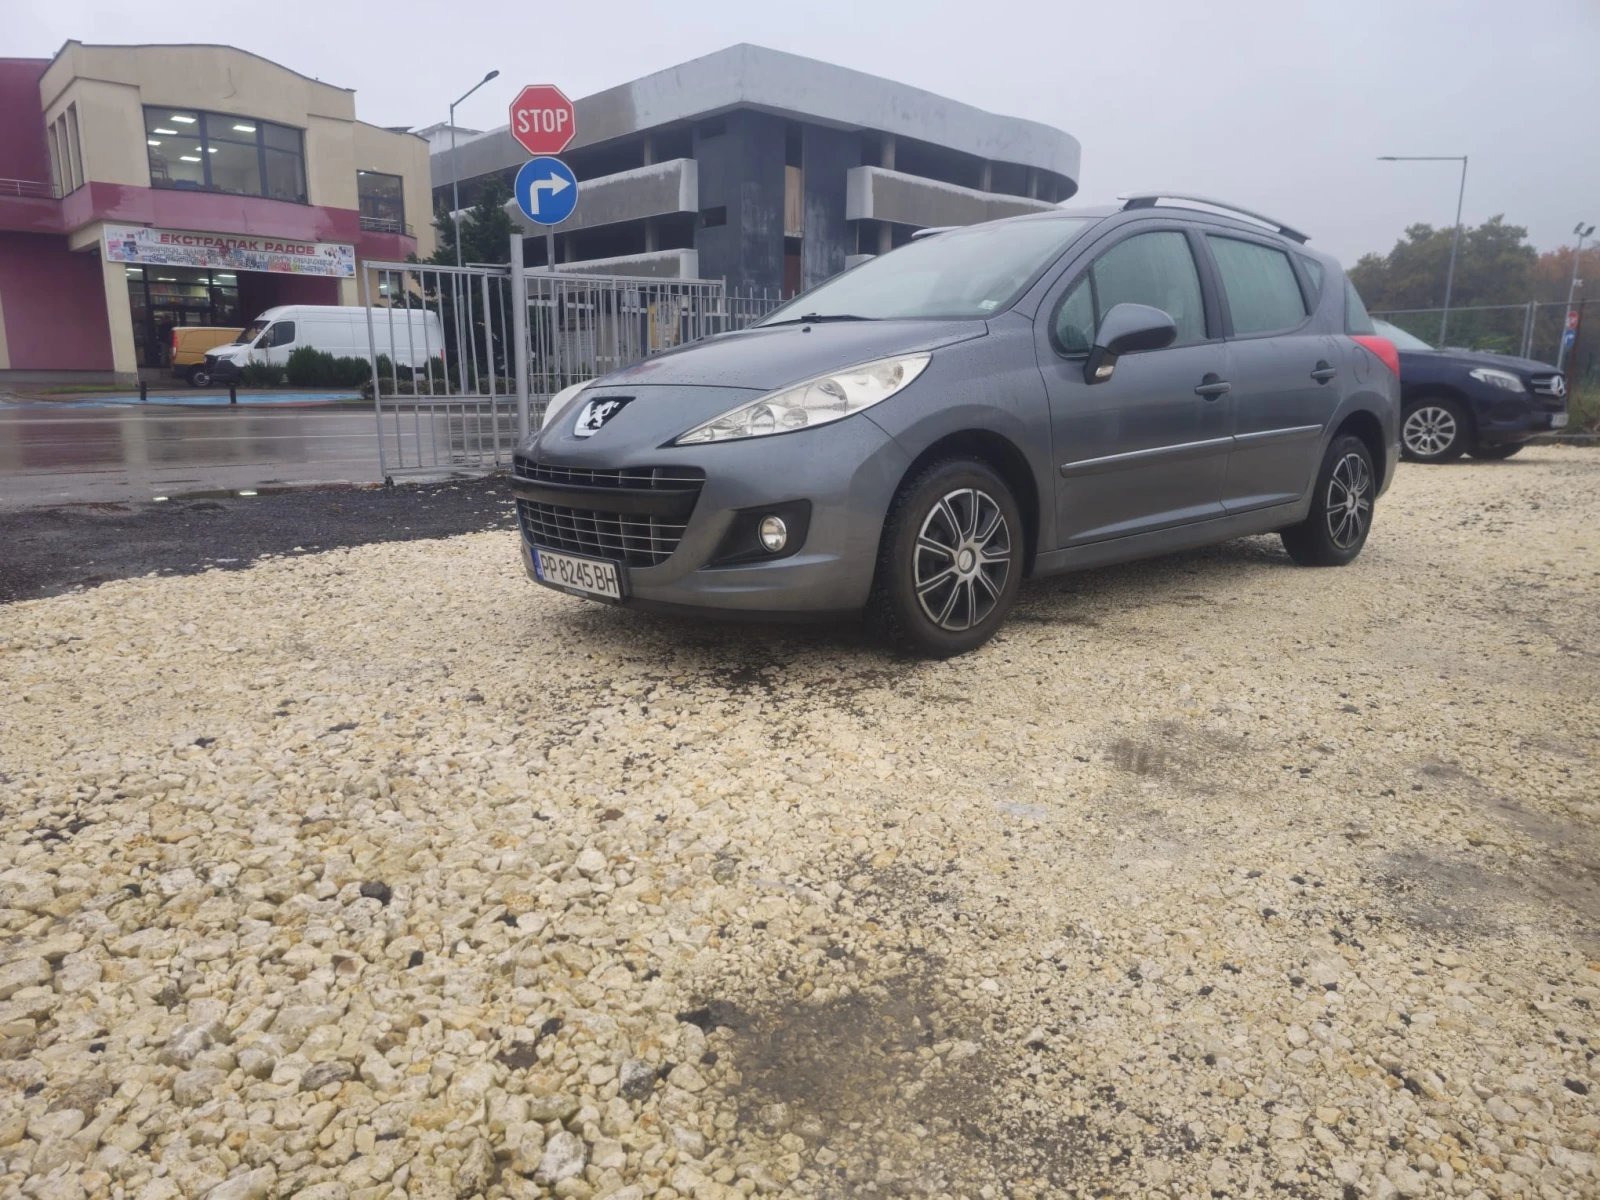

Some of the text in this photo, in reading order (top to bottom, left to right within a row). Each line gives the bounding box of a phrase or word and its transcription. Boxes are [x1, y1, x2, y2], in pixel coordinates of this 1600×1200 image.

[517, 108, 569, 133] STOP
[160, 234, 258, 250] ЕКСТРАПАК
[265, 242, 315, 255] РАДОБ
[540, 554, 617, 594] PP 8245 BH
